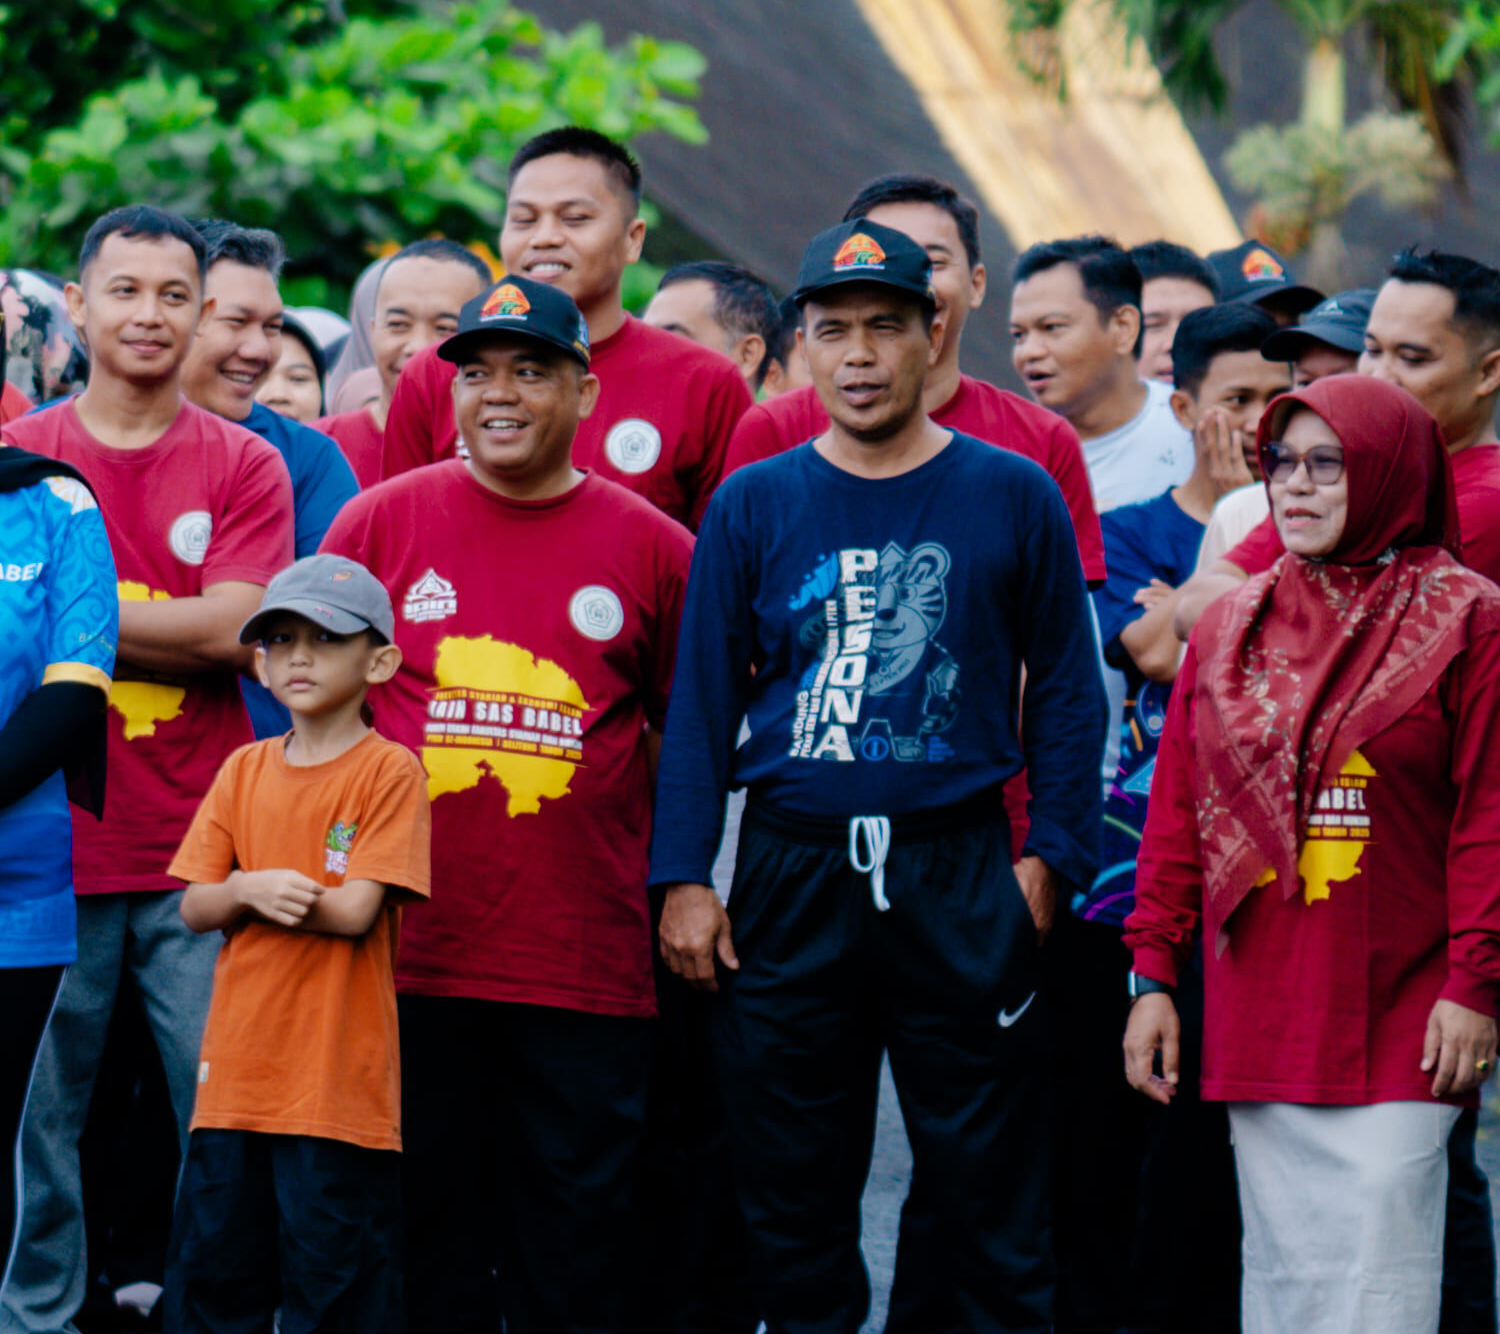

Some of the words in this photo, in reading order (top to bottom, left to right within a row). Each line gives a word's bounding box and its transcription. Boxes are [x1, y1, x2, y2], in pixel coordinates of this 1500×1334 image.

[812, 548, 879, 761] PESONA
[428, 699, 467, 719] IAIN
[475, 702, 514, 724] SAS
[523, 707, 583, 735] BABEL
[789, 690, 809, 757] BANDUNG
[1318, 787, 1366, 810] ABEL
